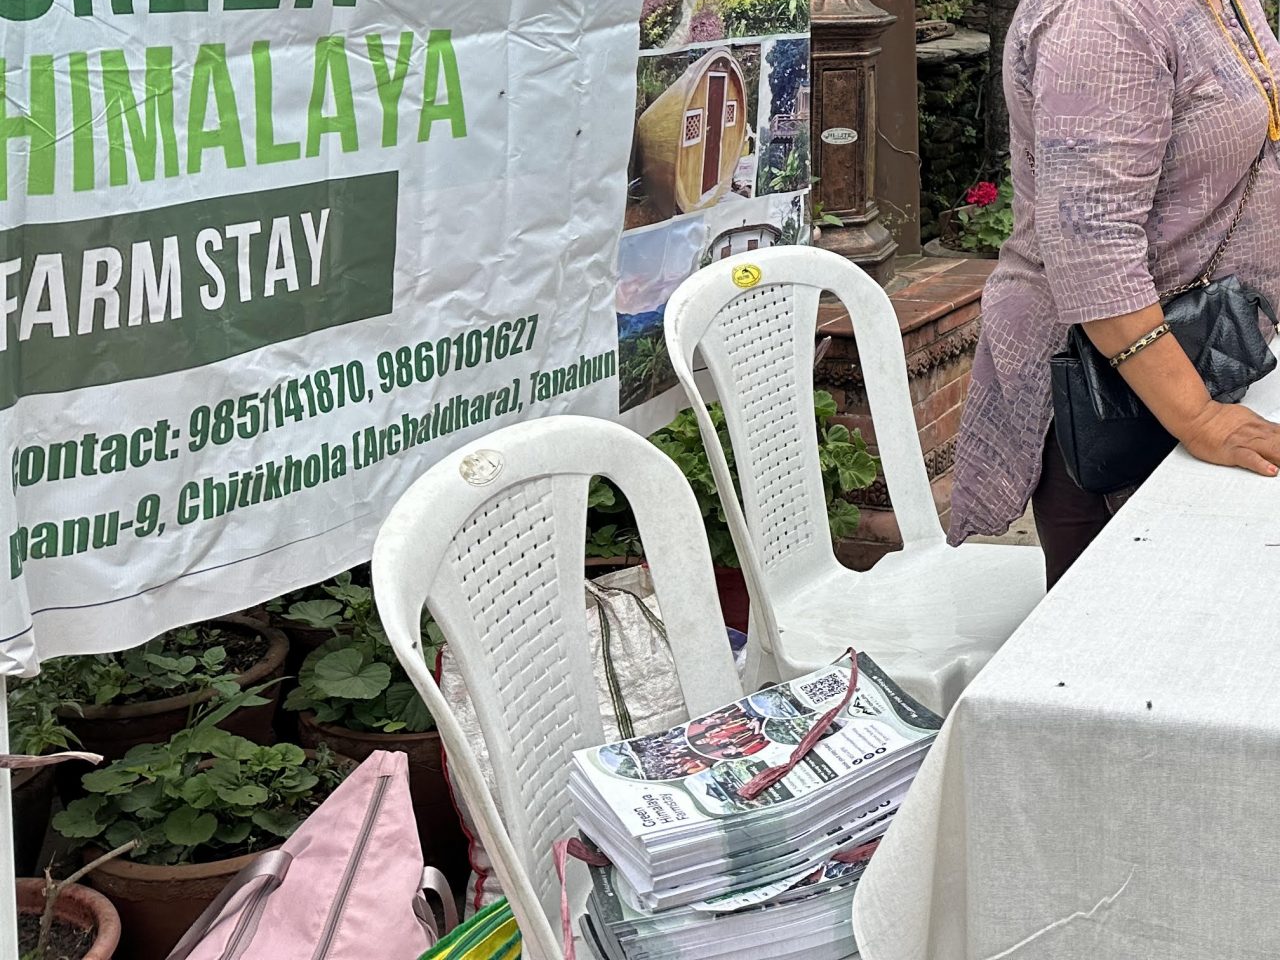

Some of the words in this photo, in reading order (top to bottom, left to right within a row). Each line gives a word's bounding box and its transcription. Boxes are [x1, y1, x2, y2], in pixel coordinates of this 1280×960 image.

[0, 28, 468, 202] HIMALAYA
[195, 208, 331, 312] STAY
[176, 440, 346, 525] Chitikhola
[529, 348, 617, 405] Tanahun
[188, 359, 374, 453] 9851141870,
[376, 313, 540, 394] 9860101627
[634, 807, 656, 827] Green
[642, 794, 674, 824] Himalaya
